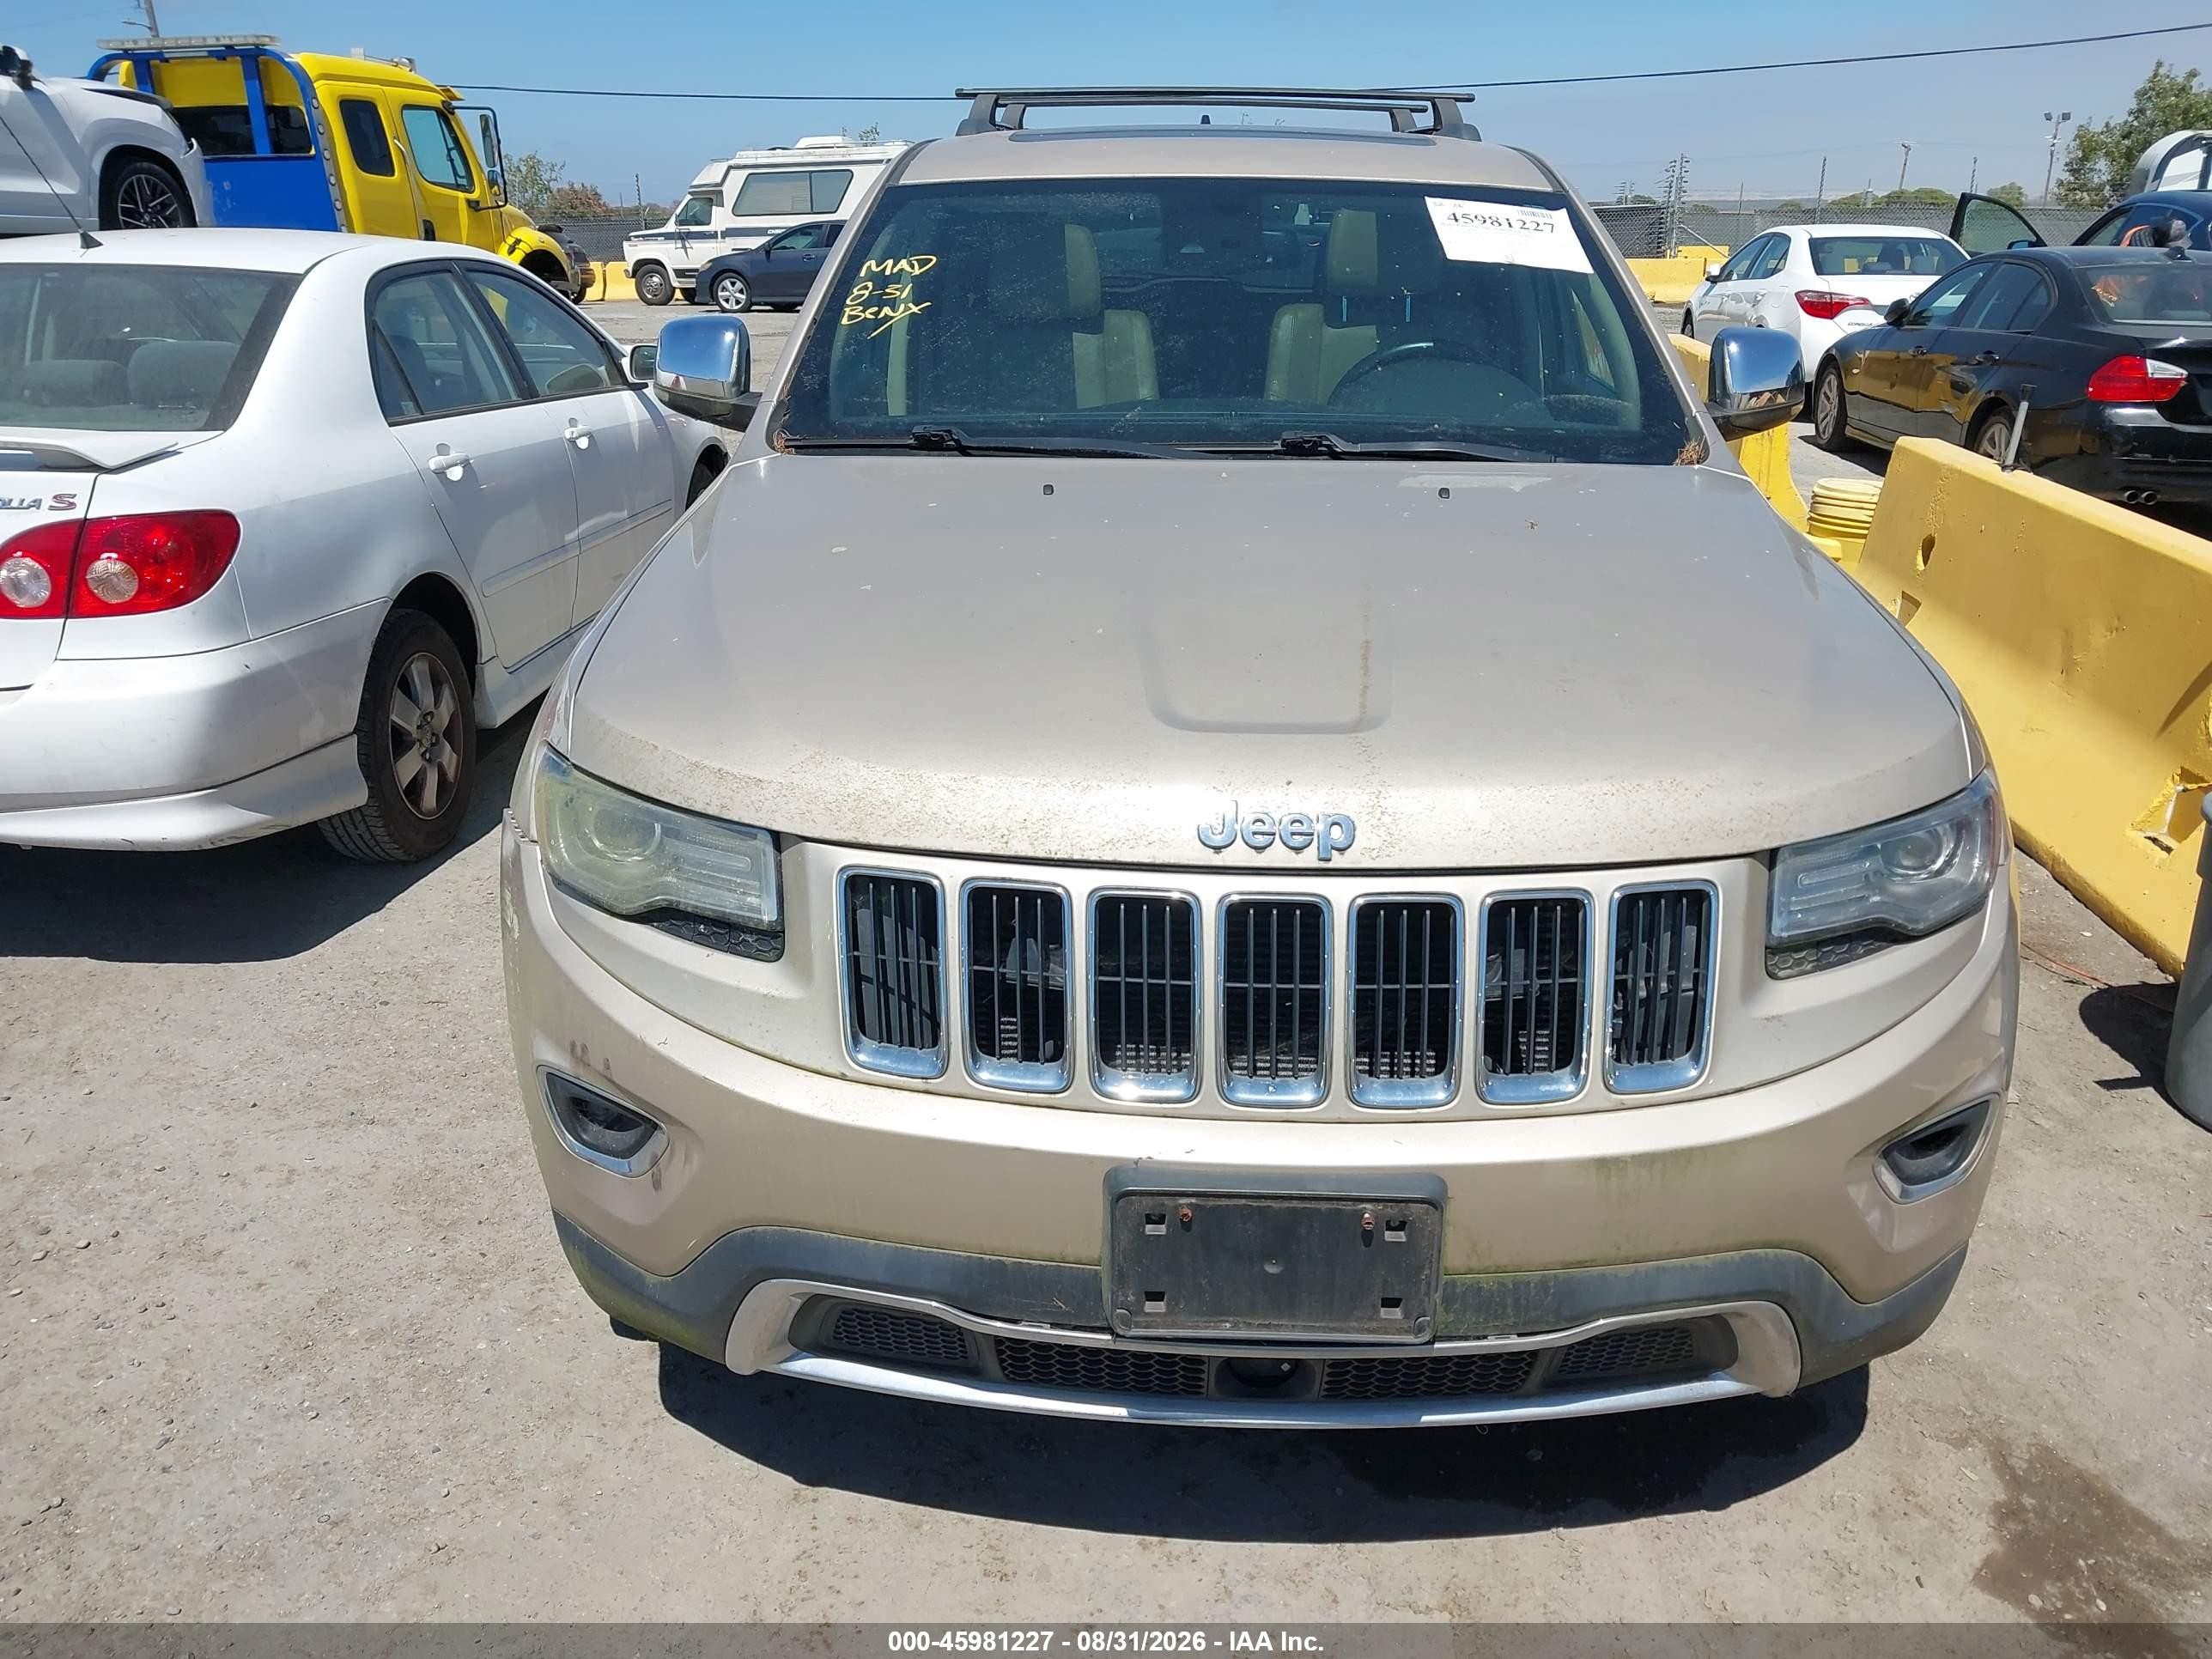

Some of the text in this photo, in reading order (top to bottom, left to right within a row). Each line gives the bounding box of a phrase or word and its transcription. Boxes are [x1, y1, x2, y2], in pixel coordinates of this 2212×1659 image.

[1447, 212, 1554, 234] 45981227
[860, 255, 937, 276] MAD
[846, 282, 913, 305] 8-31
[47, 494, 77, 511] S
[1197, 799, 1356, 861] Jeep
